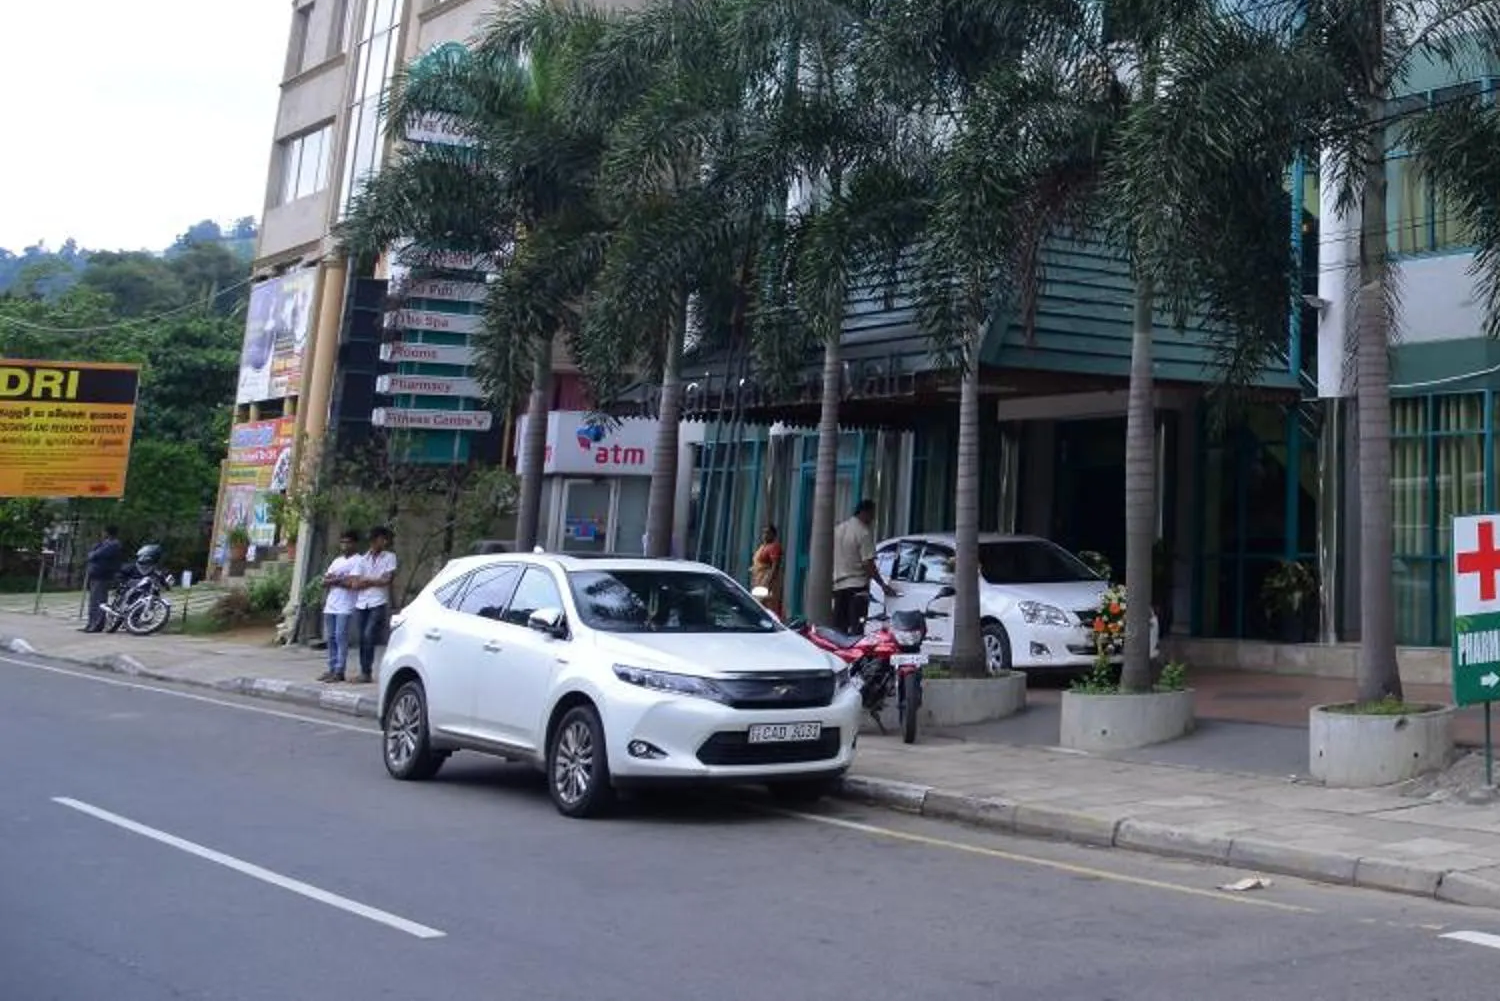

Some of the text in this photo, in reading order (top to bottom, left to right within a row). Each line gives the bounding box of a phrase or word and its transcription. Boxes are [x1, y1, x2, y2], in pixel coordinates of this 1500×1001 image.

[425, 316, 449, 328] Spa
[391, 345, 437, 359] Rooms
[391, 379, 451, 393] Pharmacy
[595, 445, 645, 465] atm
